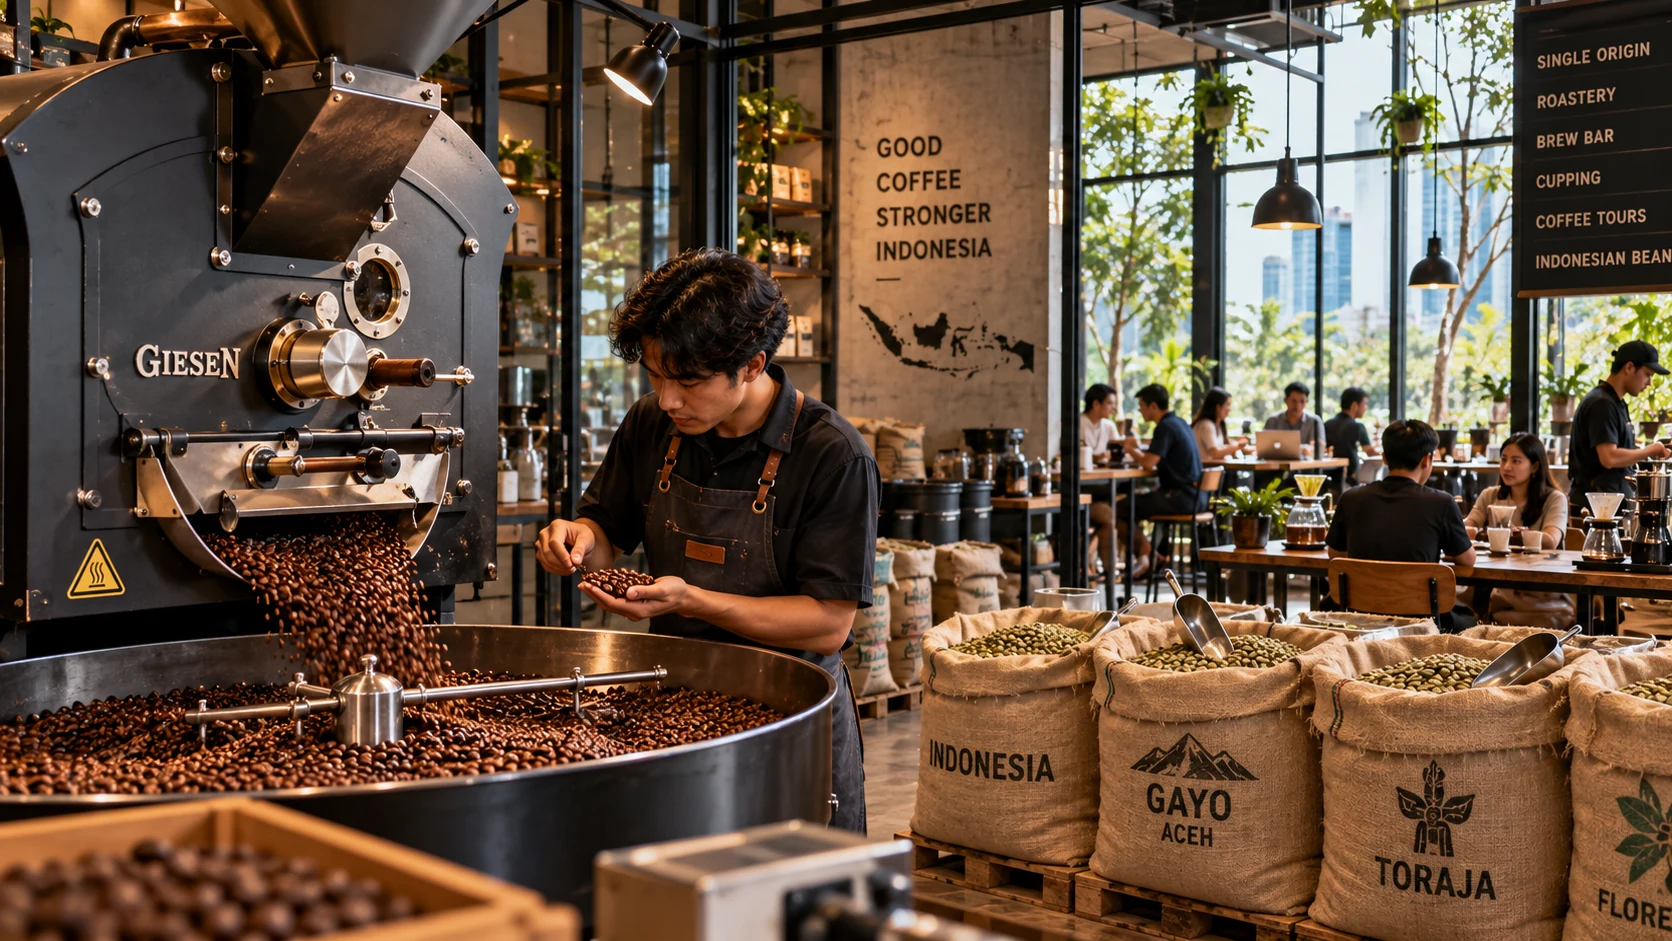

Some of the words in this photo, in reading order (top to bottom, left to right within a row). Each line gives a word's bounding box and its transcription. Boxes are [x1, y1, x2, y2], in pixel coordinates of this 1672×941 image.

[1537, 50, 1591, 70] SINGLE
[1597, 42, 1650, 61] ORIGIN
[1537, 87, 1616, 109] ROASTERY
[877, 135, 943, 159] GOOD
[1537, 131, 1579, 149] BREW
[1584, 129, 1614, 145] BAR
[877, 169, 962, 193] COFFEE
[1536, 170, 1601, 189] CUPPING
[876, 202, 992, 228] STRONGER
[1536, 212, 1591, 229] COFFEE
[1597, 208, 1647, 225] TOURS
[876, 237, 992, 262] INDONESIA
[1536, 251, 1626, 269] INDONESIAN
[1632, 249, 1672, 265] BEAN
[929, 739, 1055, 783] INDONESIA
[1147, 783, 1232, 823] GAYO
[1161, 822, 1213, 848] ACEH
[1374, 854, 1497, 901] TORAJA
[1597, 887, 1672, 932] FLORE
